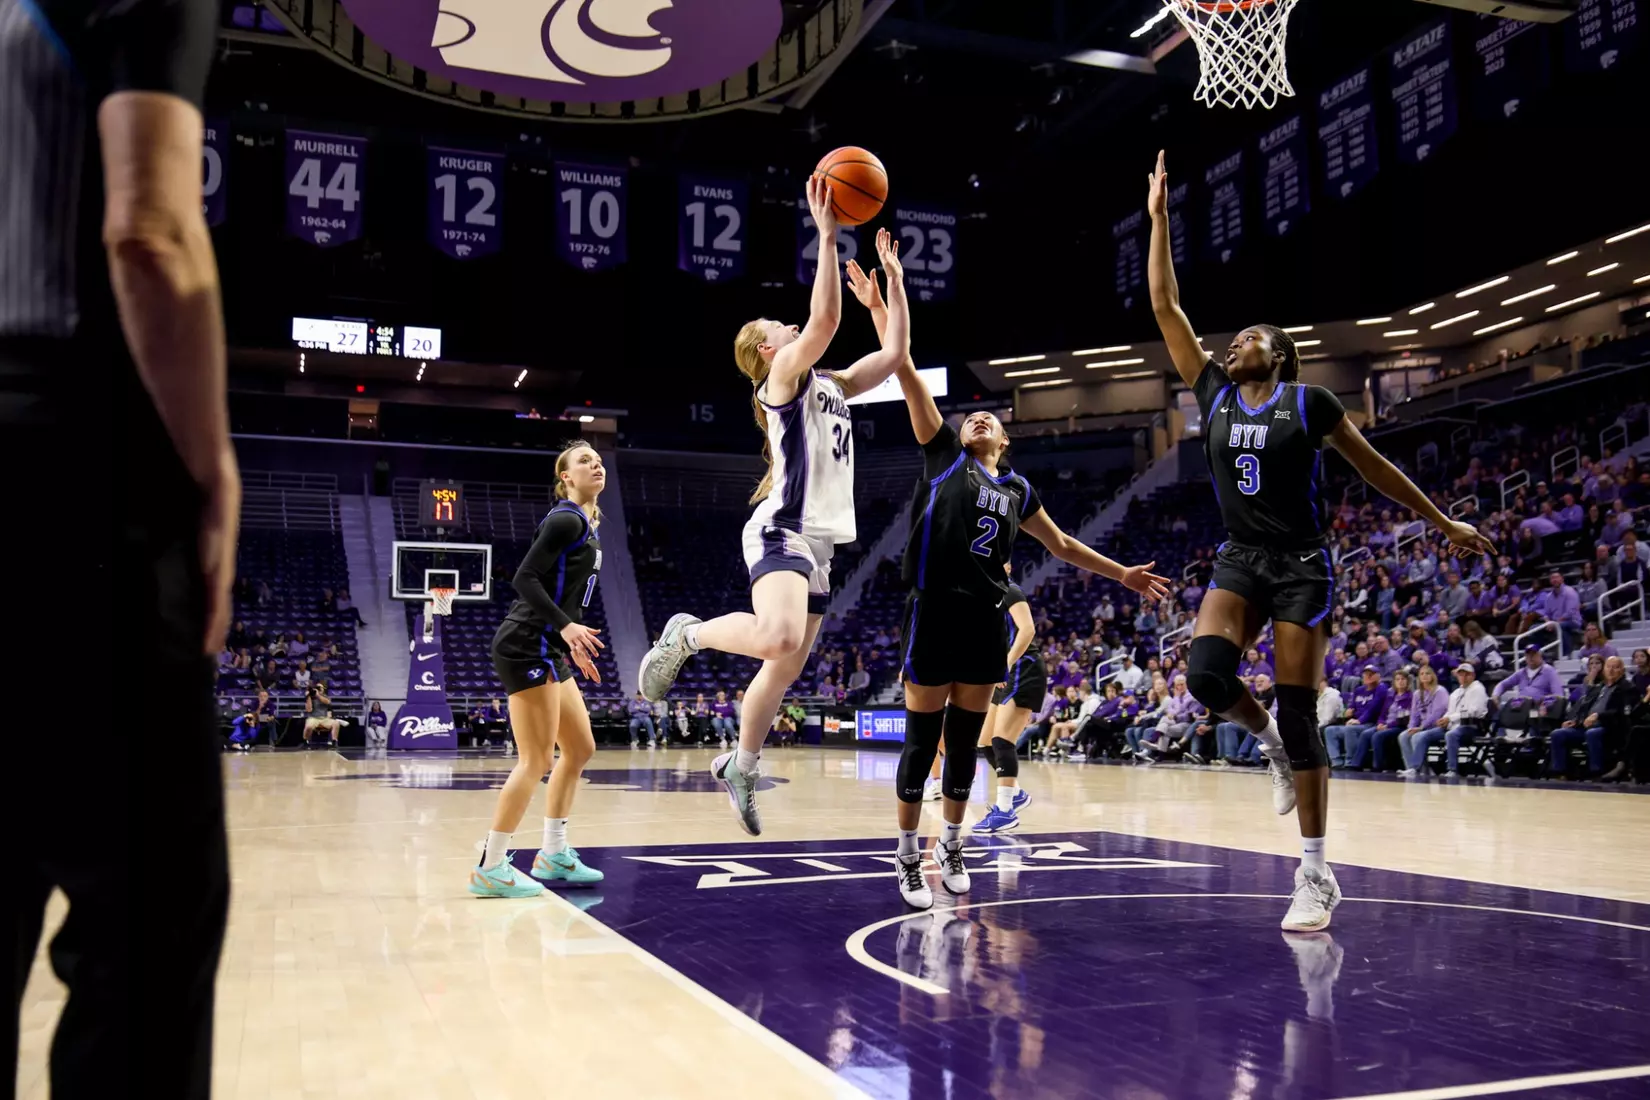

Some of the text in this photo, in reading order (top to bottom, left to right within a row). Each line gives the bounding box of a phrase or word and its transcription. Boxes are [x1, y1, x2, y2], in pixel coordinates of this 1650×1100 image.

[1393, 22, 1446, 67] K-STATE
[294, 139, 359, 157] MURRELL
[439, 156, 492, 172] KRUGER
[289, 157, 360, 212] 44
[560, 170, 622, 187] WILLIAMS
[434, 173, 496, 227] 12
[694, 185, 733, 200] EVANS
[301, 215, 347, 229] 1962-64
[561, 187, 620, 239] 10
[896, 208, 956, 225] RICHMOND
[442, 229, 486, 242] 1971-74
[685, 202, 741, 251] 12
[569, 242, 611, 255] 1972-76
[900, 225, 953, 273] 23
[337, 332, 358, 346] 27
[412, 338, 433, 352] 20
[689, 403, 714, 423] 15
[832, 423, 851, 467] 34
[1229, 423, 1269, 449] BYU
[1235, 453, 1261, 495] 3
[432, 489, 457, 501] 4:54
[976, 485, 1010, 516] BYU
[436, 502, 453, 520] 17
[970, 515, 999, 558] 2
[398, 715, 454, 738] Dillons
